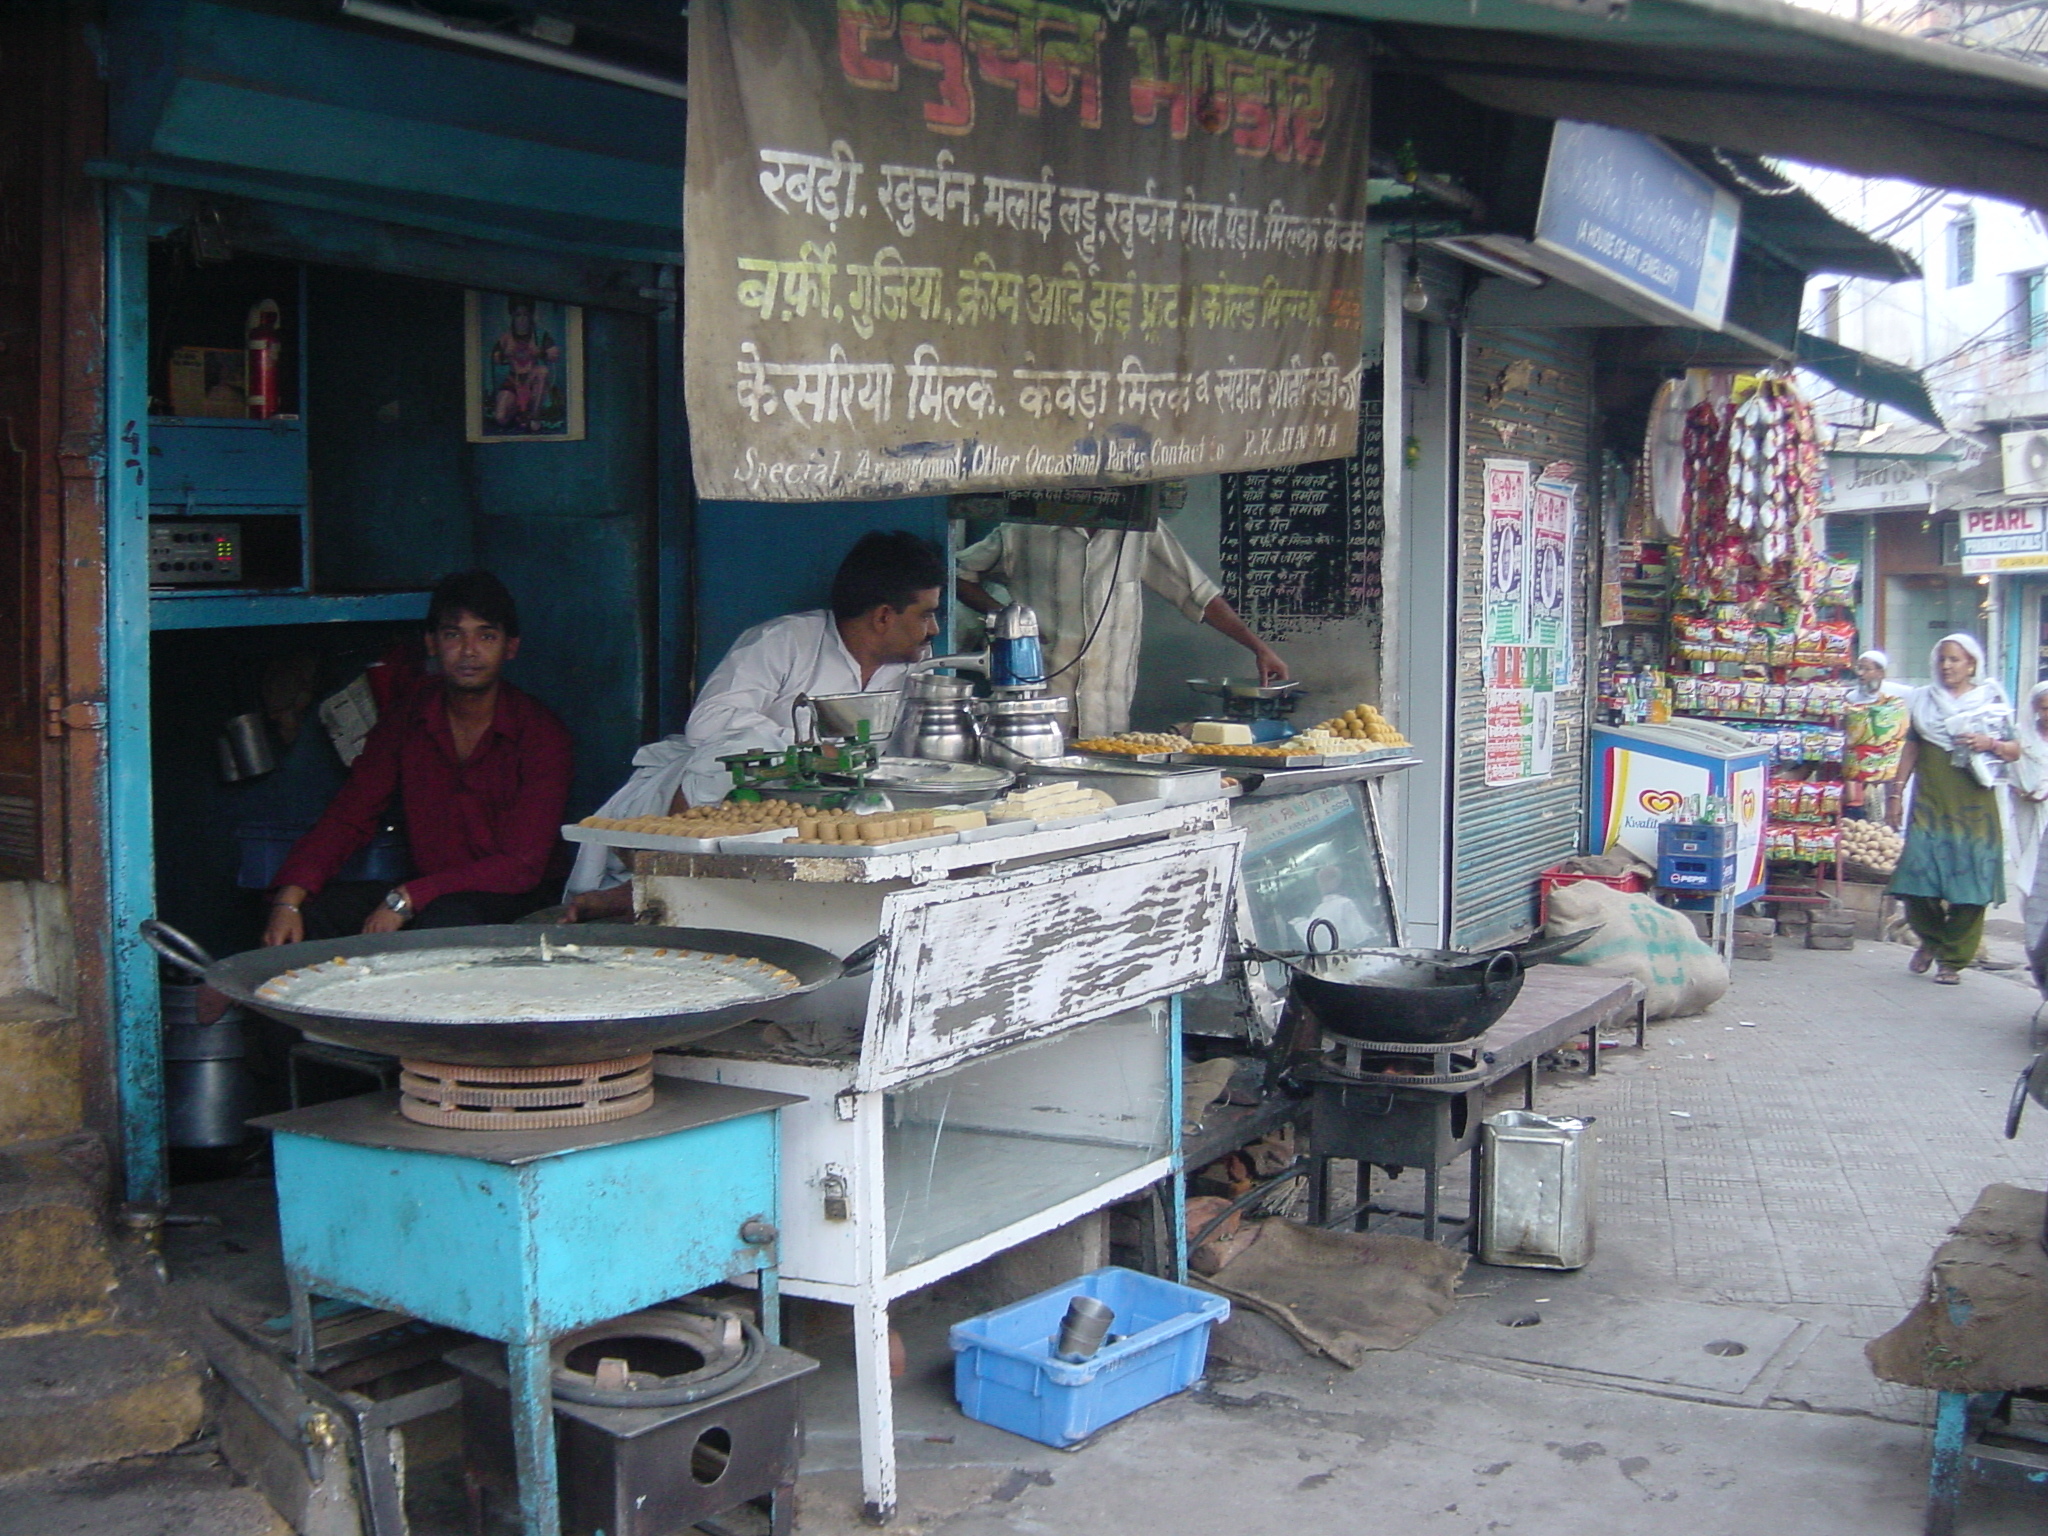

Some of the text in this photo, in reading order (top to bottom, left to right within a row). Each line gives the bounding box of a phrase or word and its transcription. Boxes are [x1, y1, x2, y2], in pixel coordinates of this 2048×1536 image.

[984, 164, 1056, 243] मलाई
[1587, 225, 1616, 257] HOUSE
[737, 341, 896, 432] केसरिया
[1117, 354, 1194, 420] मिल्क
[734, 447, 842, 490] Special
[972, 444, 1021, 477] Other
[1025, 439, 1103, 476] Occasional
[1105, 439, 1147, 471] Parties
[1152, 436, 1204, 465] Contact
[1243, 503, 1267, 516] मटर
[1967, 508, 2034, 533] PEARL
[1353, 520, 1361, 531] 3
[1247, 551, 1282, 568] गुलाब
[1624, 815, 1660, 834] Kwalit
